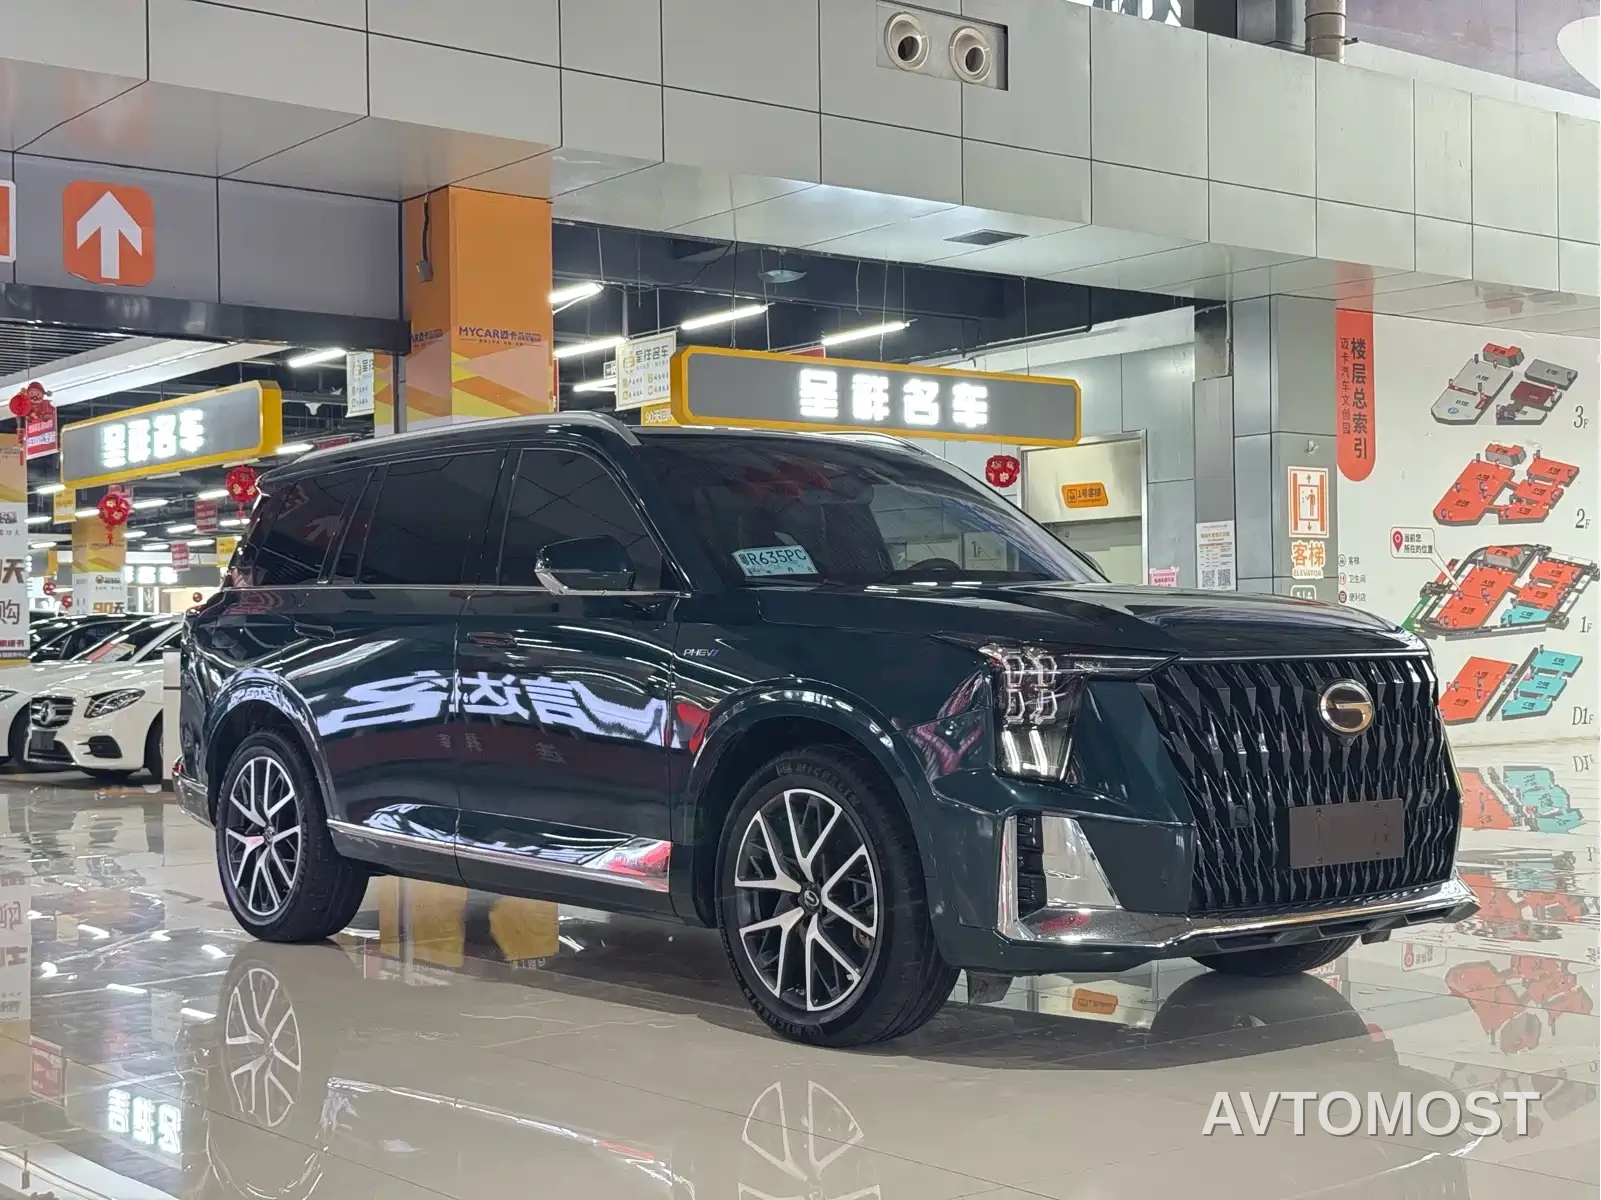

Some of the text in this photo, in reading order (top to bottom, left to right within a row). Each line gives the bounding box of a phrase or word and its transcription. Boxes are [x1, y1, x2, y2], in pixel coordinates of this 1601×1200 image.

[1340, 337, 1351, 435] 迈卡汽车文创园
[1351, 337, 1368, 460] 楼层总索引
[1573, 405, 1589, 429] 3F
[1575, 508, 1592, 529] 2F
[1292, 543, 1324, 566] 客梯
[1293, 569, 1322, 577] ELEVATOR
[1580, 616, 1592, 634] 1F
[682, 648, 720, 657] PHEV
[1571, 706, 1595, 726] D1F
